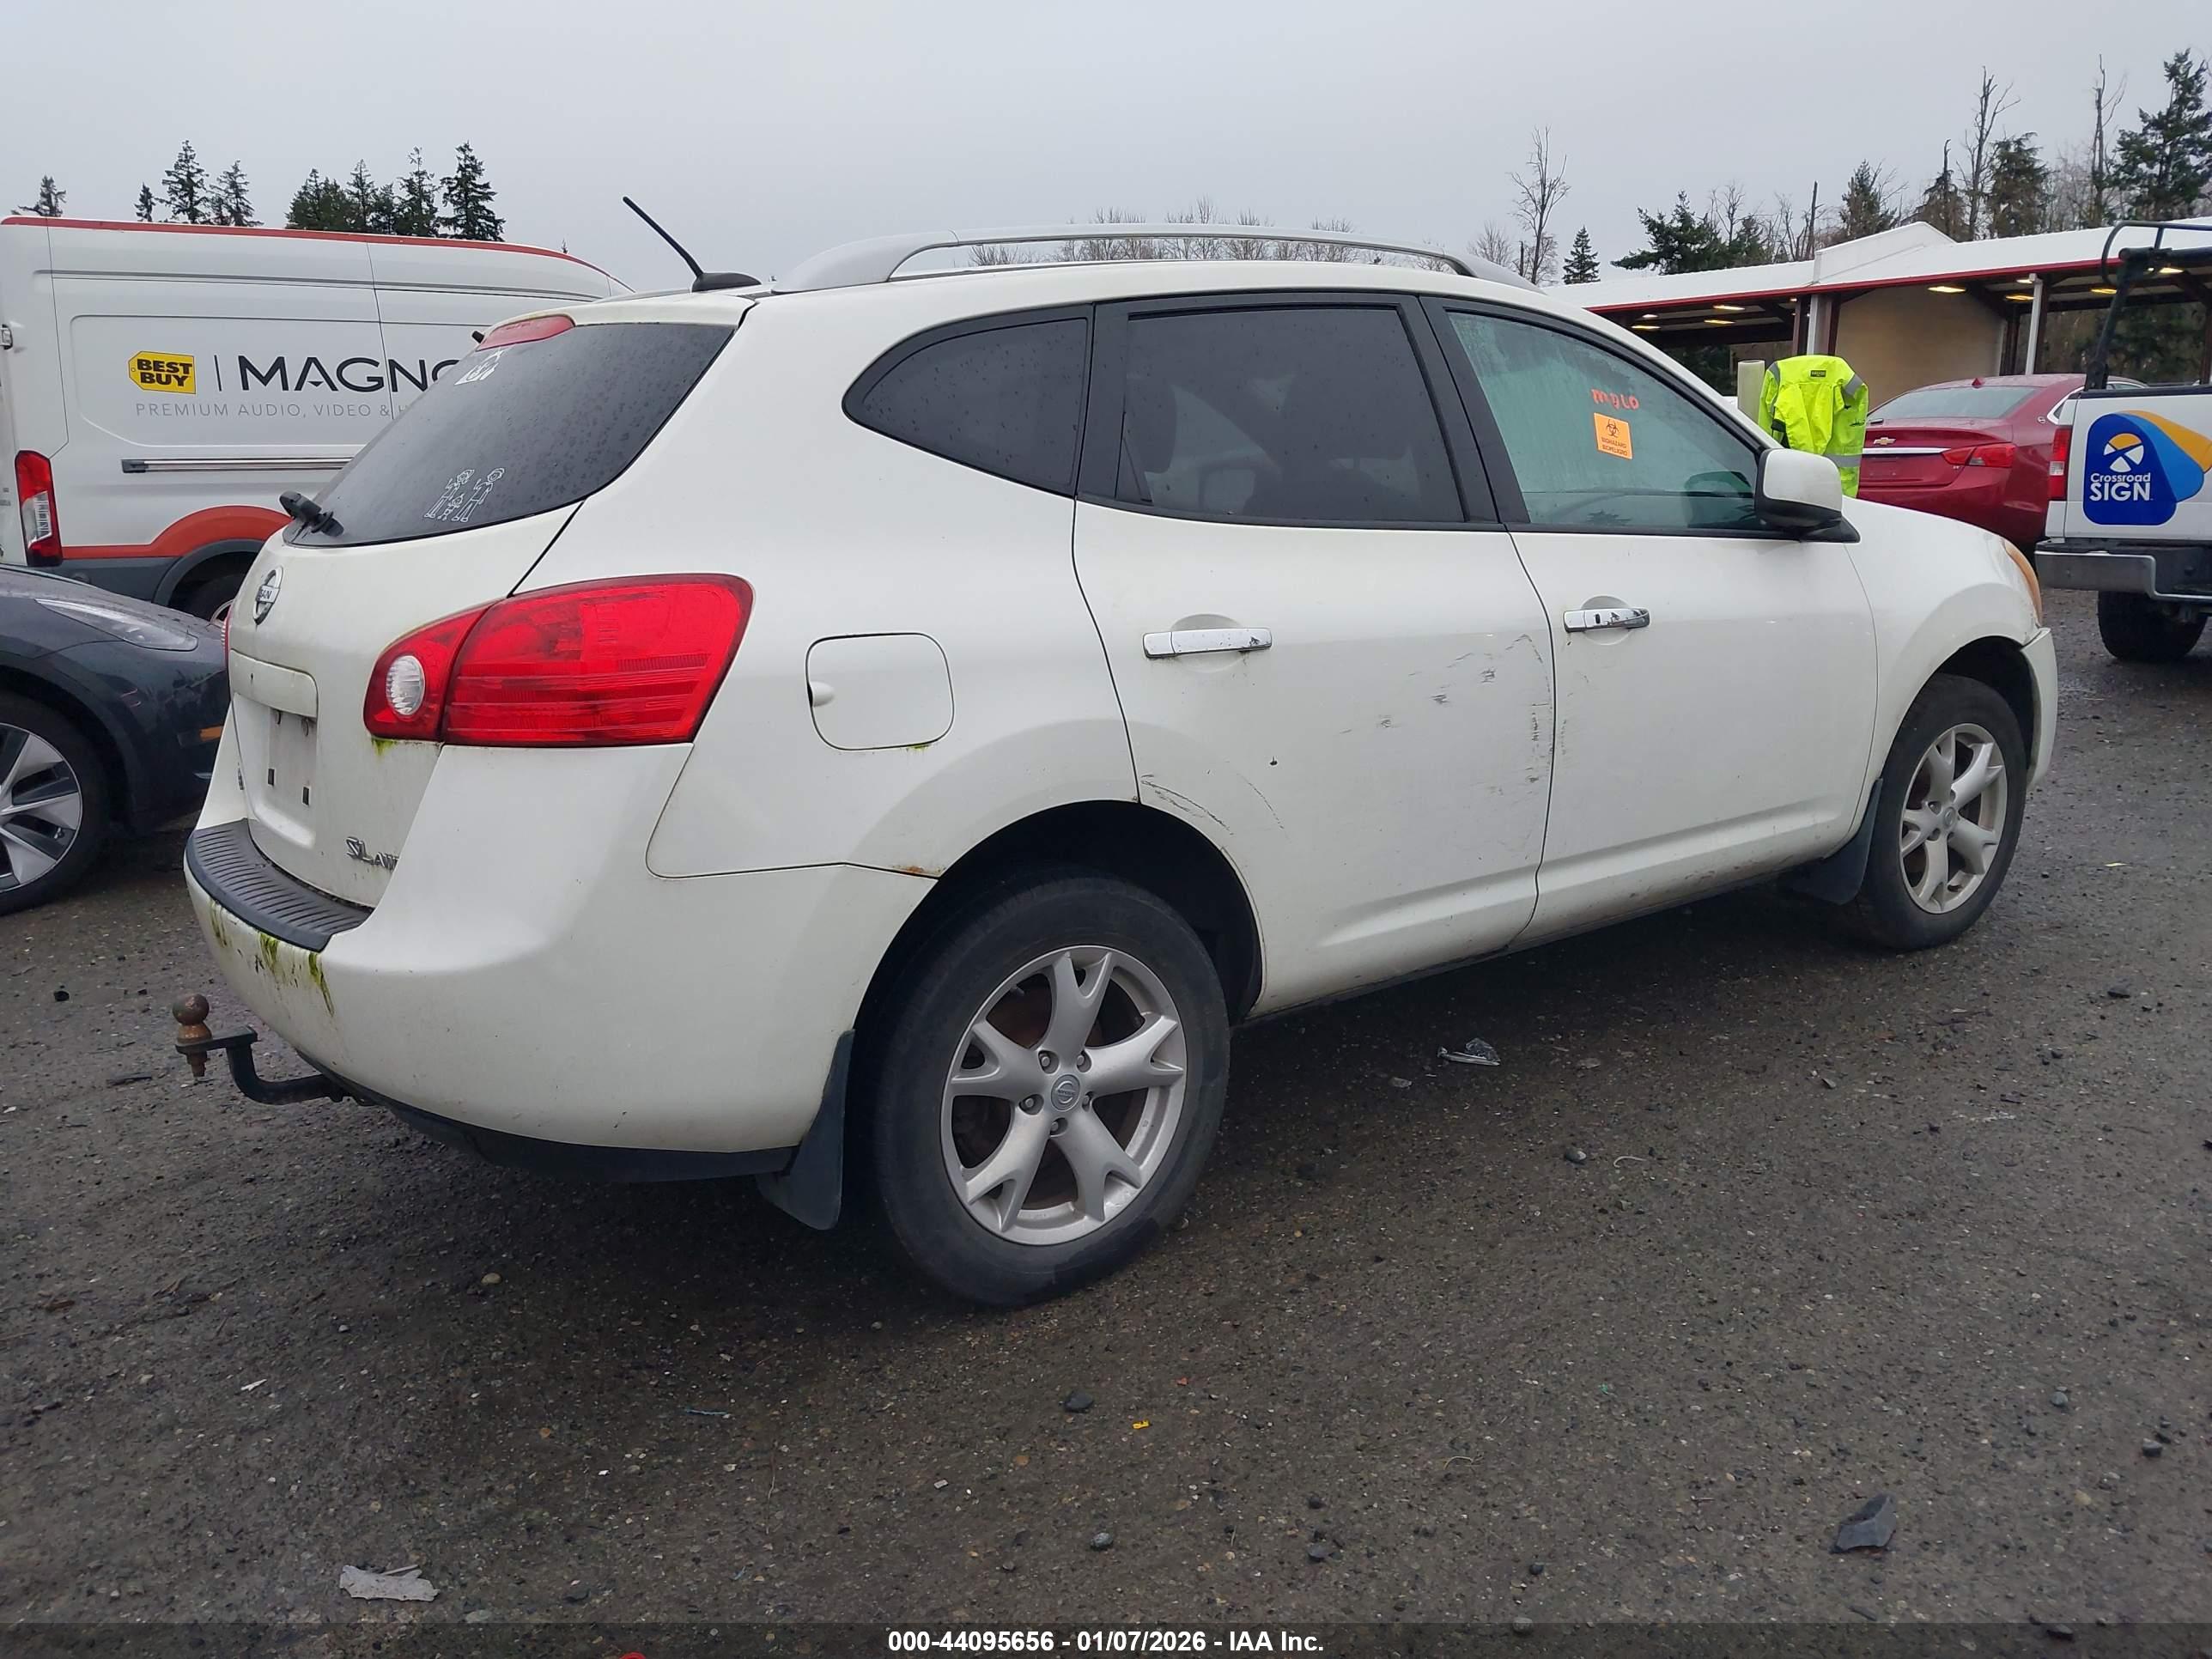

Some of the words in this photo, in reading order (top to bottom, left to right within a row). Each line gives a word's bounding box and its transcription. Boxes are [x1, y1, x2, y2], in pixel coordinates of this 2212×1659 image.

[137, 358, 193, 374] BEST
[140, 371, 190, 387] BUY
[136, 403, 228, 416] PREMIUM
[238, 404, 306, 418] AUDIO,
[313, 404, 371, 416] VIDEO
[380, 404, 391, 416] &
[2090, 472, 2151, 483] Crossroad
[2089, 482, 2151, 501] SIGN
